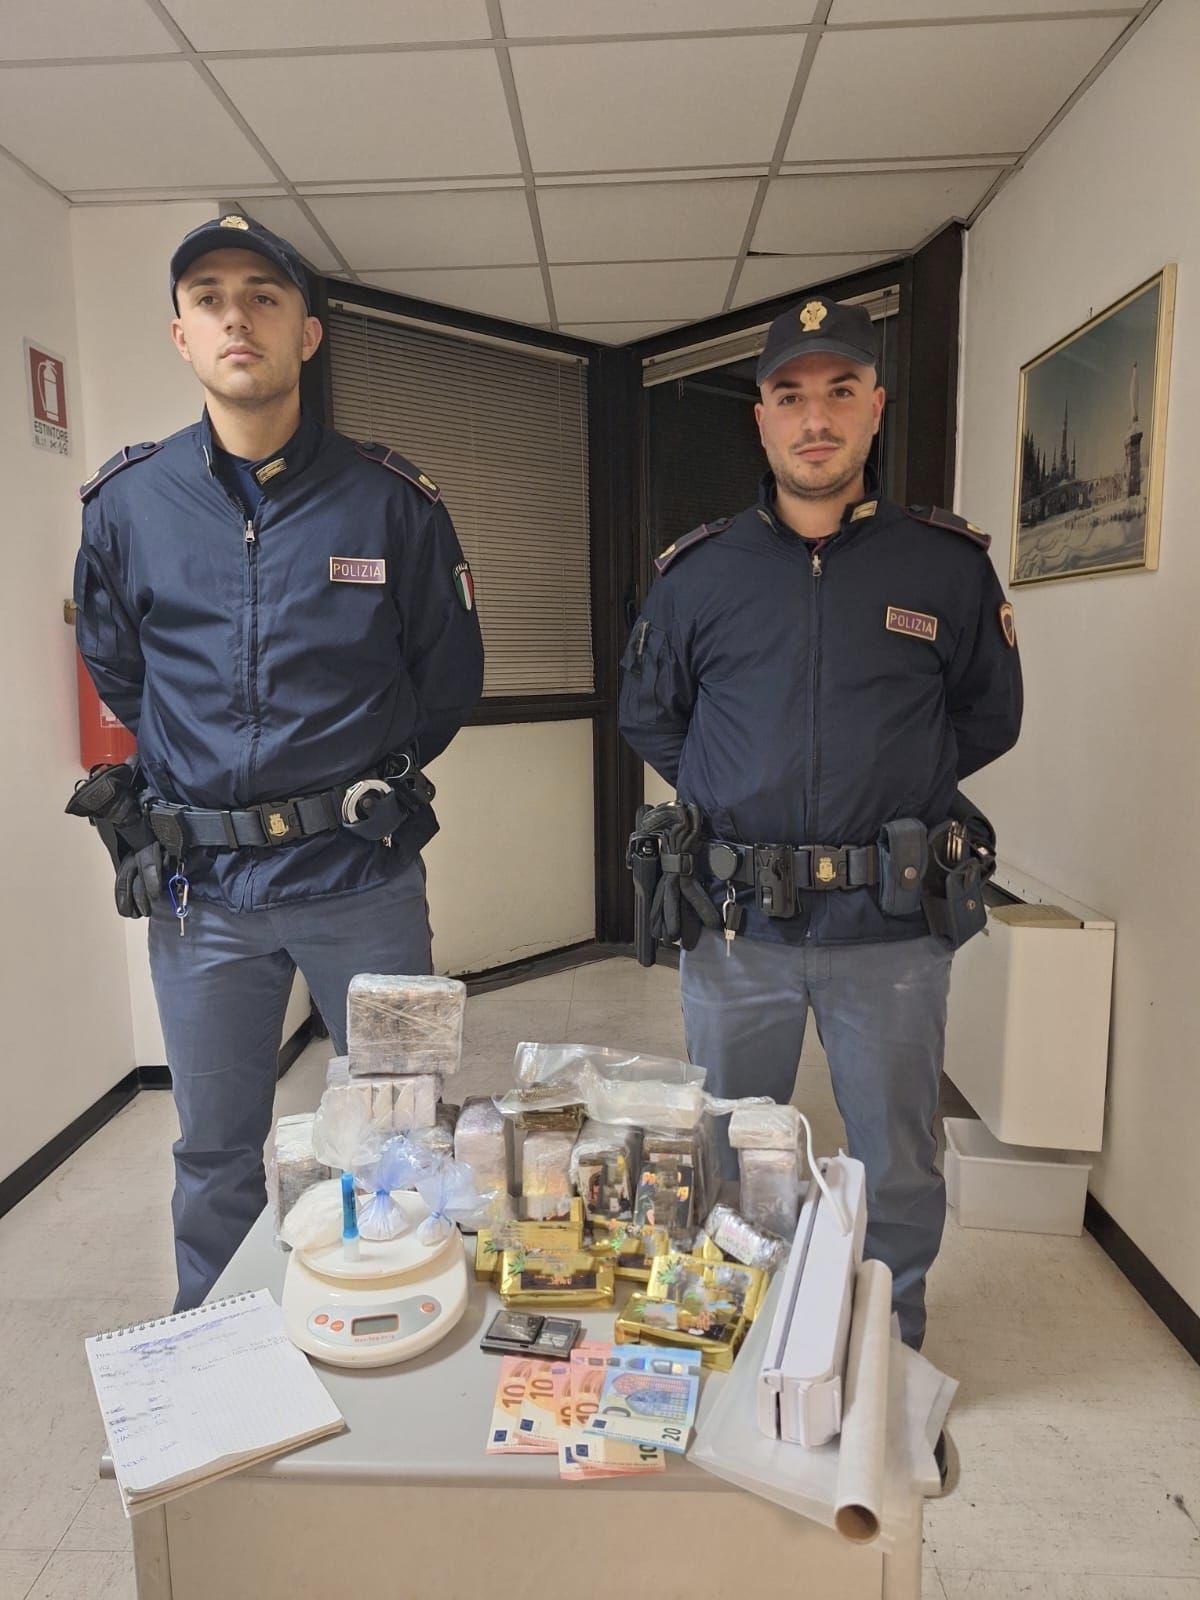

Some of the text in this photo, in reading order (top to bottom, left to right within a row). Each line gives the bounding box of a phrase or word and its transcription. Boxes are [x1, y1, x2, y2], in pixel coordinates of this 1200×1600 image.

[34, 421, 68, 443] ESTINTORE
[333, 563, 382, 578] POLIZIA
[891, 613, 932, 634] POLIZIA
[502, 1384, 525, 1408] 10
[530, 1379, 554, 1400] 10
[661, 1427, 681, 1442] 20
